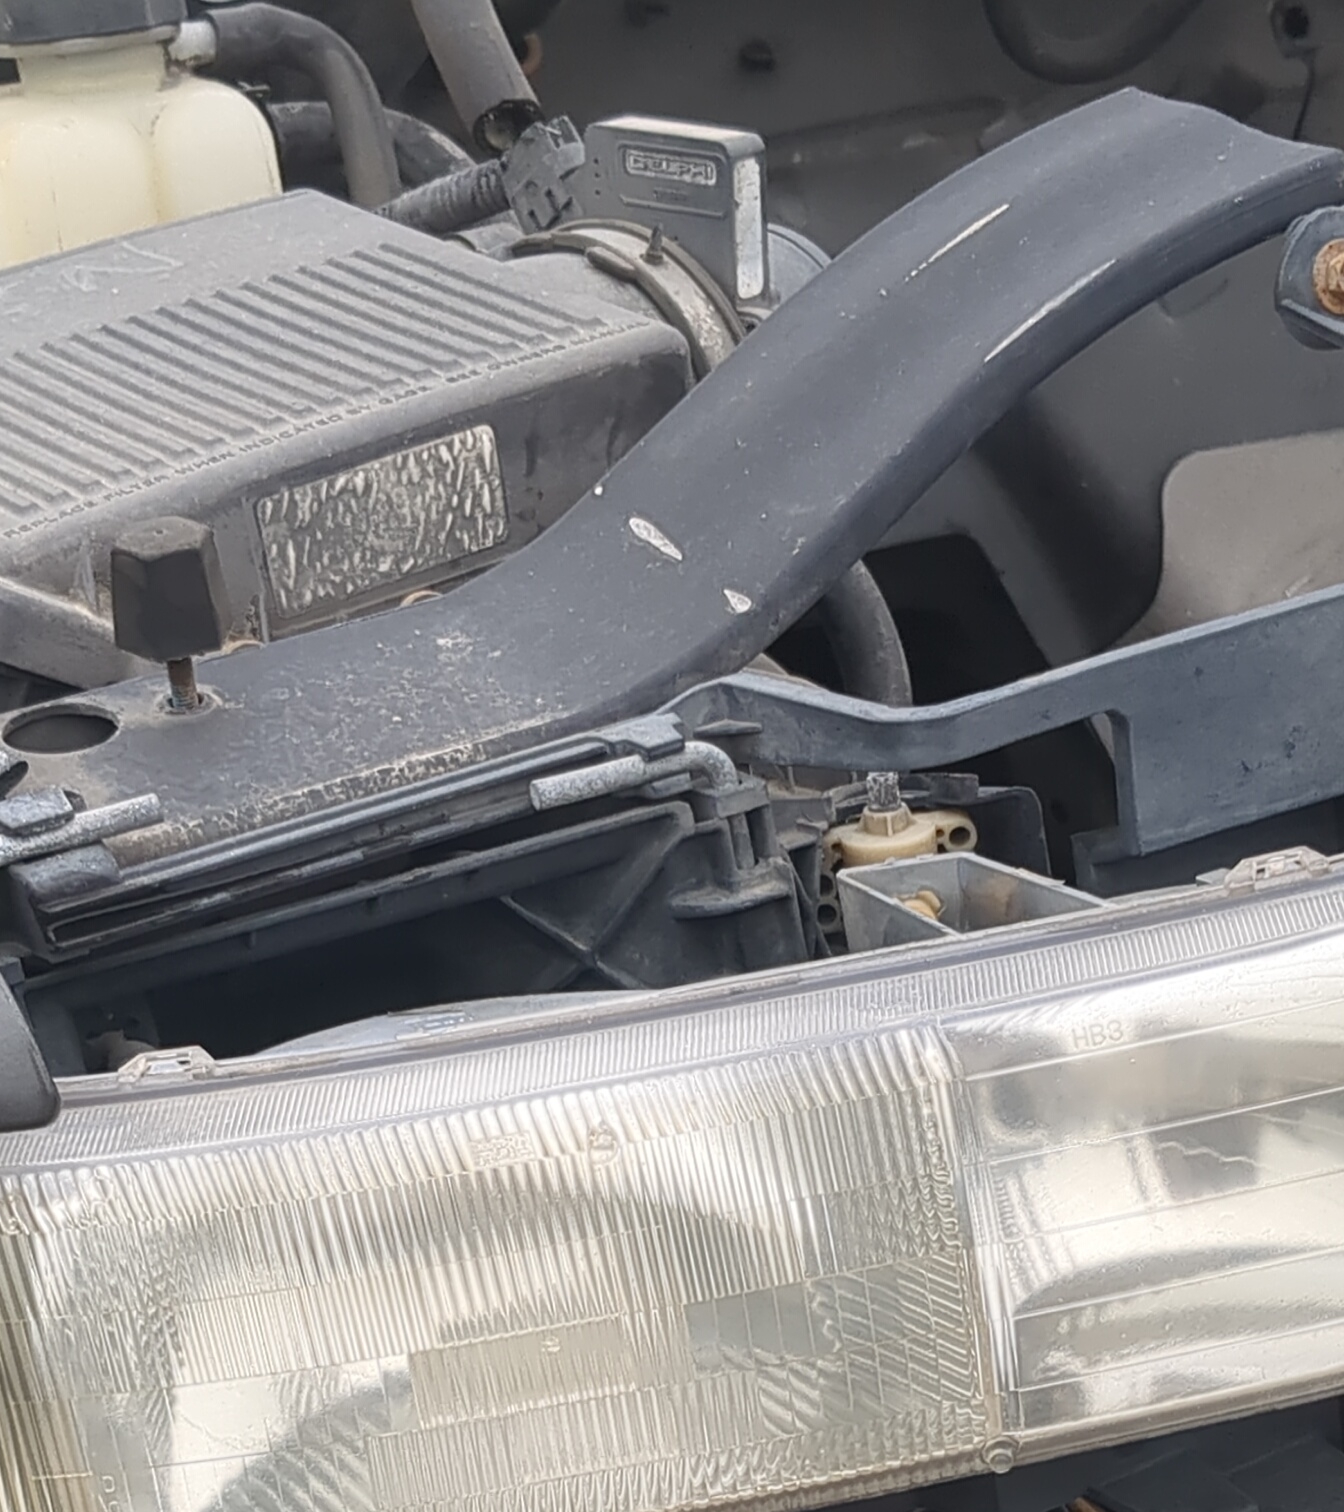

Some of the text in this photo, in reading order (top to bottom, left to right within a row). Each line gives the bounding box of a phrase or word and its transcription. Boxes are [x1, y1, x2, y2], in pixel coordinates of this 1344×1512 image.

[3, 501, 98, 538] REPLACE
[103, 474, 170, 502] FILTER
[174, 451, 235, 475] WHEN
[239, 413, 343, 453] INDICATED
[1071, 1020, 1124, 1050] HB3
